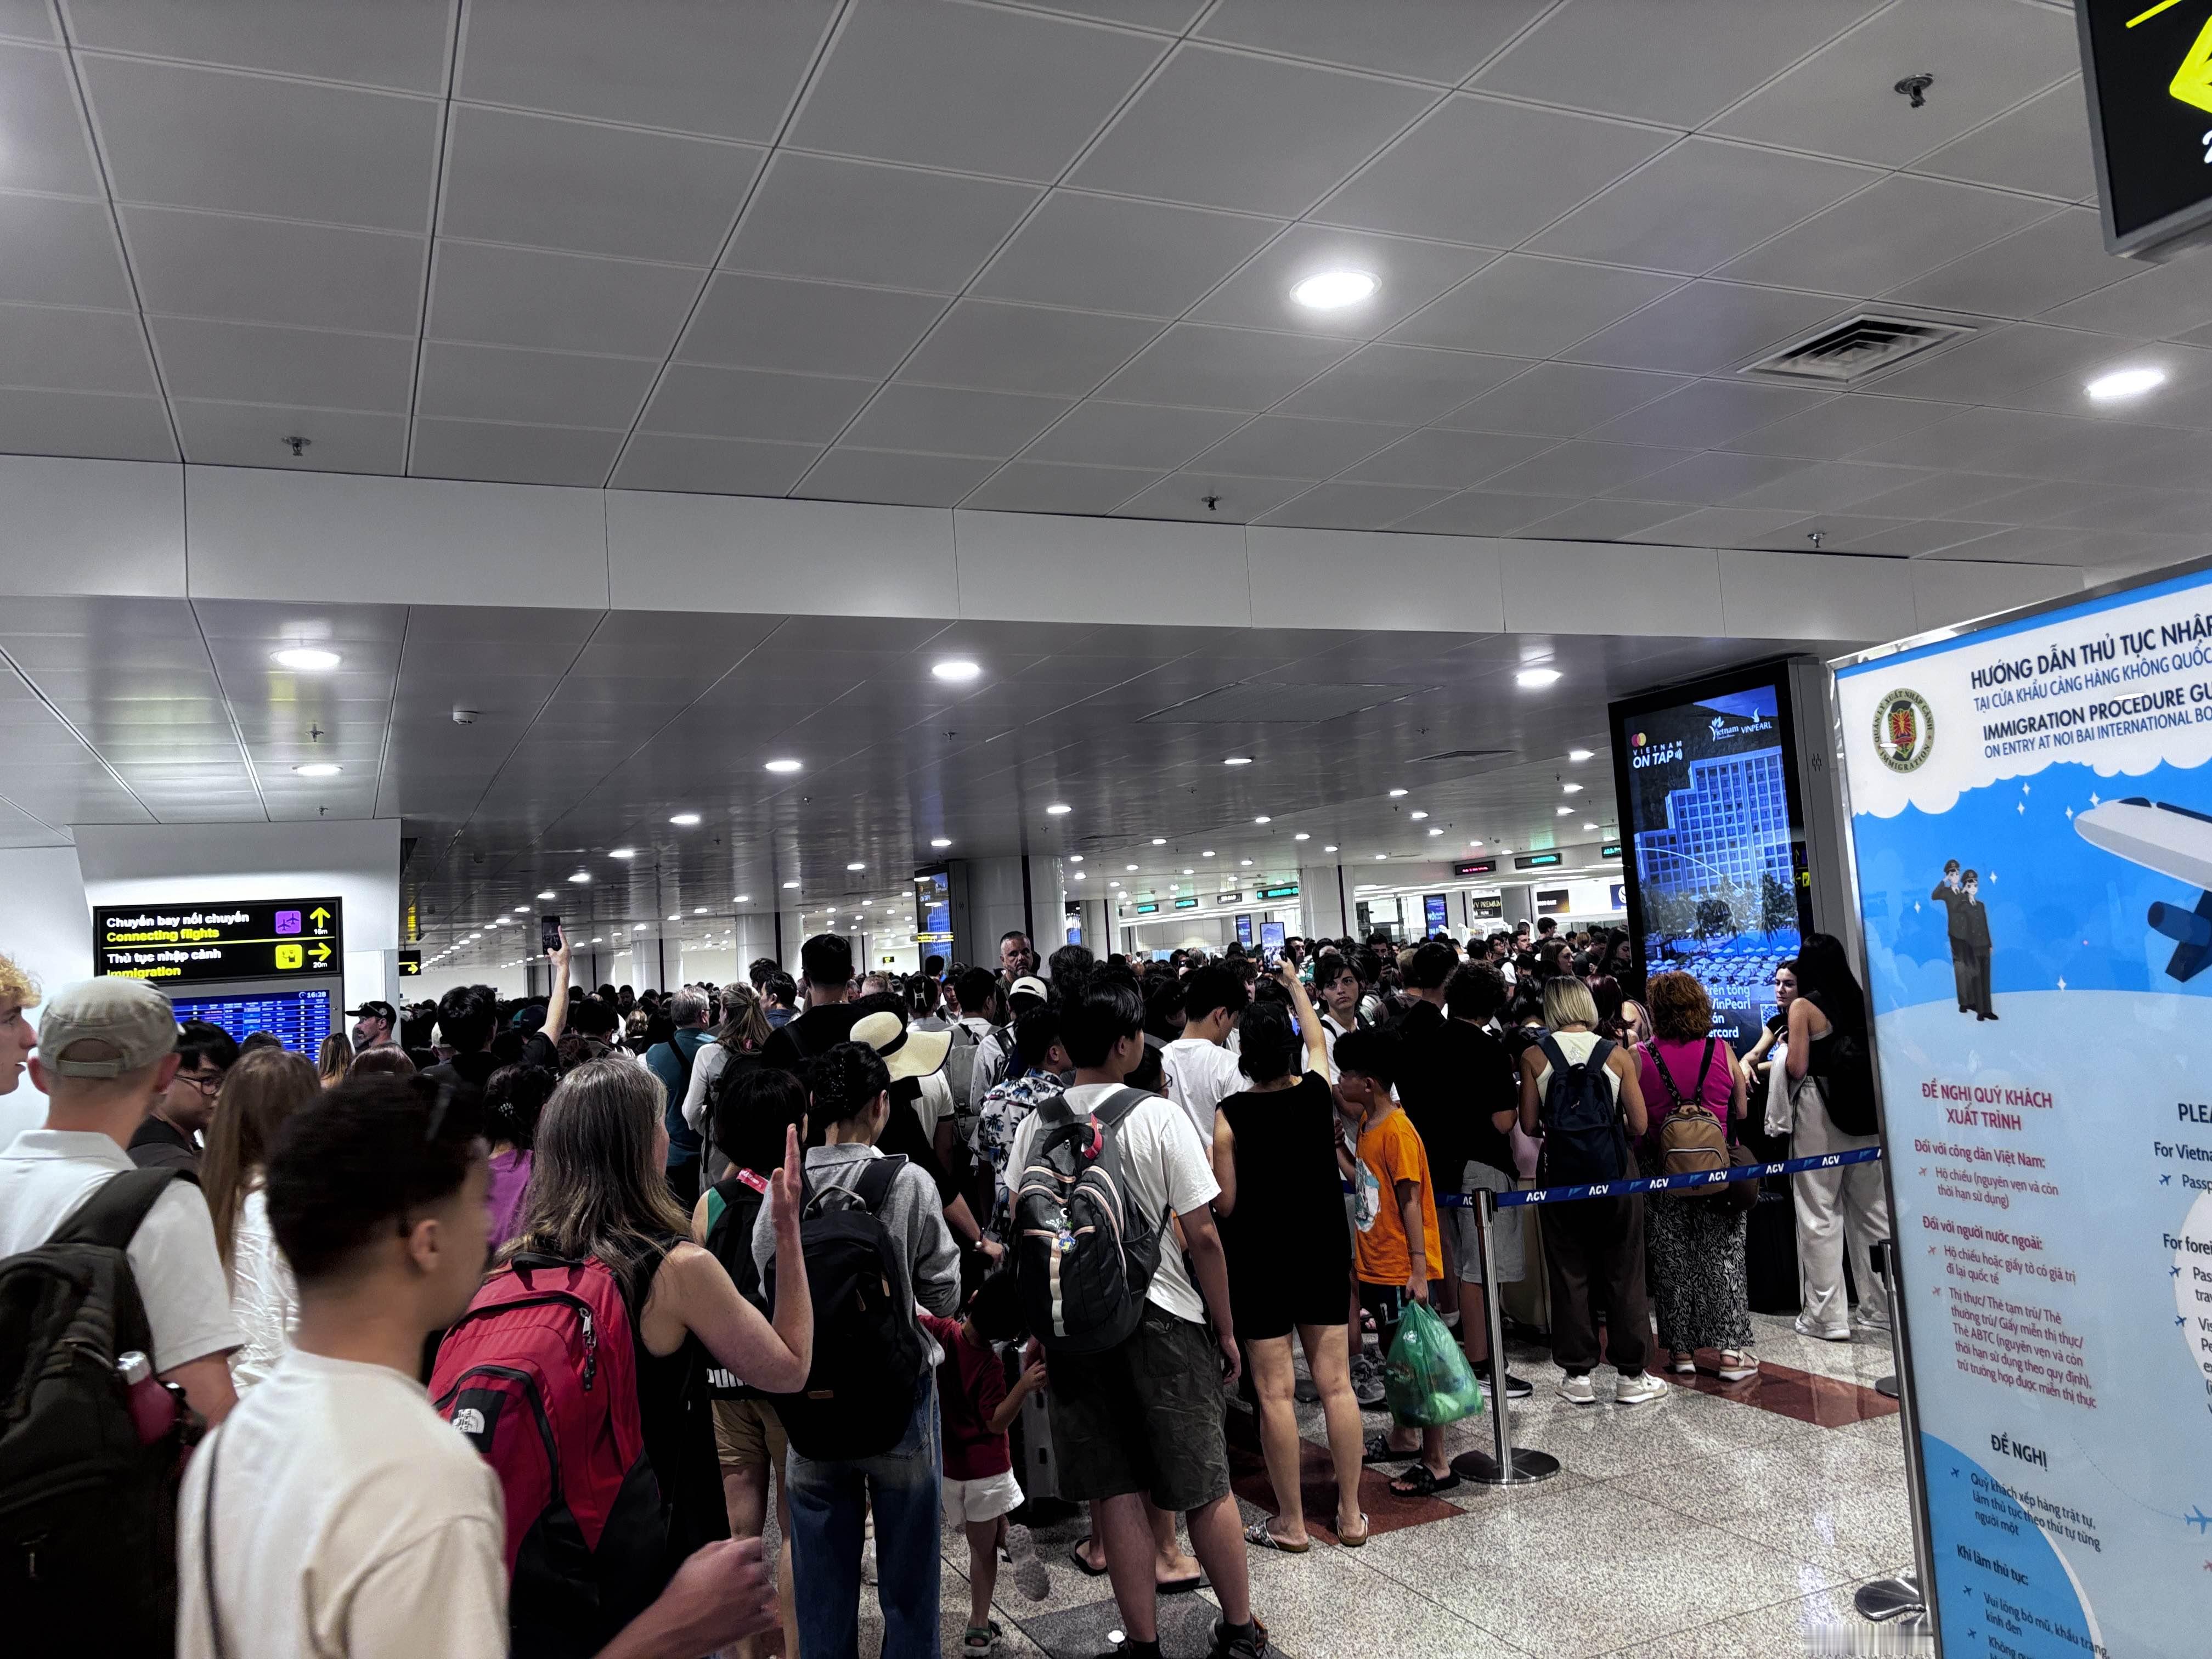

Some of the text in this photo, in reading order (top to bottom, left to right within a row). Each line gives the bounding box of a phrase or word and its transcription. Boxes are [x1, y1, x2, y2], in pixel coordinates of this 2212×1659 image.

[1971, 659, 2033, 689] HƯỚNG
[2037, 644, 2076, 674] DẪN
[2080, 633, 2115, 664] THỦ
[2119, 629, 2156, 658] TỤC
[1973, 643, 2212, 713] TẠI CỬA KHẨU CẢNG HÀNG KHÔNG QUỐC
[1983, 687, 2185, 741] IMMIGRATION PROCEDURE
[1741, 721, 1773, 733] VINPEARL
[1984, 744, 2000, 758] ON
[2003, 737, 2035, 755] ENTRY
[2038, 735, 2050, 749] AT
[2053, 731, 2074, 747] NOI
[2076, 727, 2095, 743] BAI
[2098, 710, 2192, 739] INTERNATIONAL
[1633, 741, 1683, 755] VIETNAM
[1633, 750, 1674, 769] ON TAP
[106, 915, 155, 929] Chuyến
[157, 916, 180, 927] bay
[205, 911, 250, 925] chuyến
[107, 928, 219, 942] Connecting flights
[107, 949, 222, 964] Thủ tục nhập cảnh
[107, 967, 181, 979] Immigration
[1708, 1026, 1739, 1038] ercard
[1922, 1078, 2053, 1109] ĐỀ NGHỊ QUÝ KHÁCH
[1946, 1102, 2022, 1131] XUẤT TRÌNH
[2178, 1103, 2212, 1124] PLE
[1915, 1139, 2046, 1169] Đối với công dân Việt Nam:
[2154, 1141, 2173, 1158] For
[1463, 1155, 1839, 1205] AC ACV ACV ACV ACV ACV ACV
[2028, 1181, 2039, 1194] và
[1955, 1187, 1971, 1202] hạn
[1984, 1193, 2010, 1210] dụng)
[1922, 1216, 1939, 1231] Đối
[1940, 1220, 1955, 1233] với
[1957, 1225, 1983, 1240] người
[2012, 1235, 2042, 1251] ngoài:
[2163, 1233, 2182, 1250] For
[1971, 1327, 1995, 1344] ABTC
[2052, 1350, 2064, 1362] và
[2066, 1352, 2083, 1367] còn
[1972, 1344, 1988, 1361] hạn
[2025, 1359, 2044, 1375] theo
[2046, 1368, 2063, 1383] quy
[1990, 1431, 2048, 1472] ĐỀ NGHỊ
[1972, 1489, 1989, 1507] làm
[2008, 1504, 2022, 1520] tục
[2023, 1510, 2045, 1527] theo
[1990, 1479, 2017, 1500] khách
[2019, 1491, 2036, 1507] xếp
[2037, 1496, 2061, 1519] hàng
[2000, 1521, 2019, 1536] một
[1957, 1544, 1972, 1562] Khi
[1973, 1550, 1991, 1570] làm
[1983, 1592, 1999, 1608] Vui
[2005, 1620, 2023, 1637] đen
